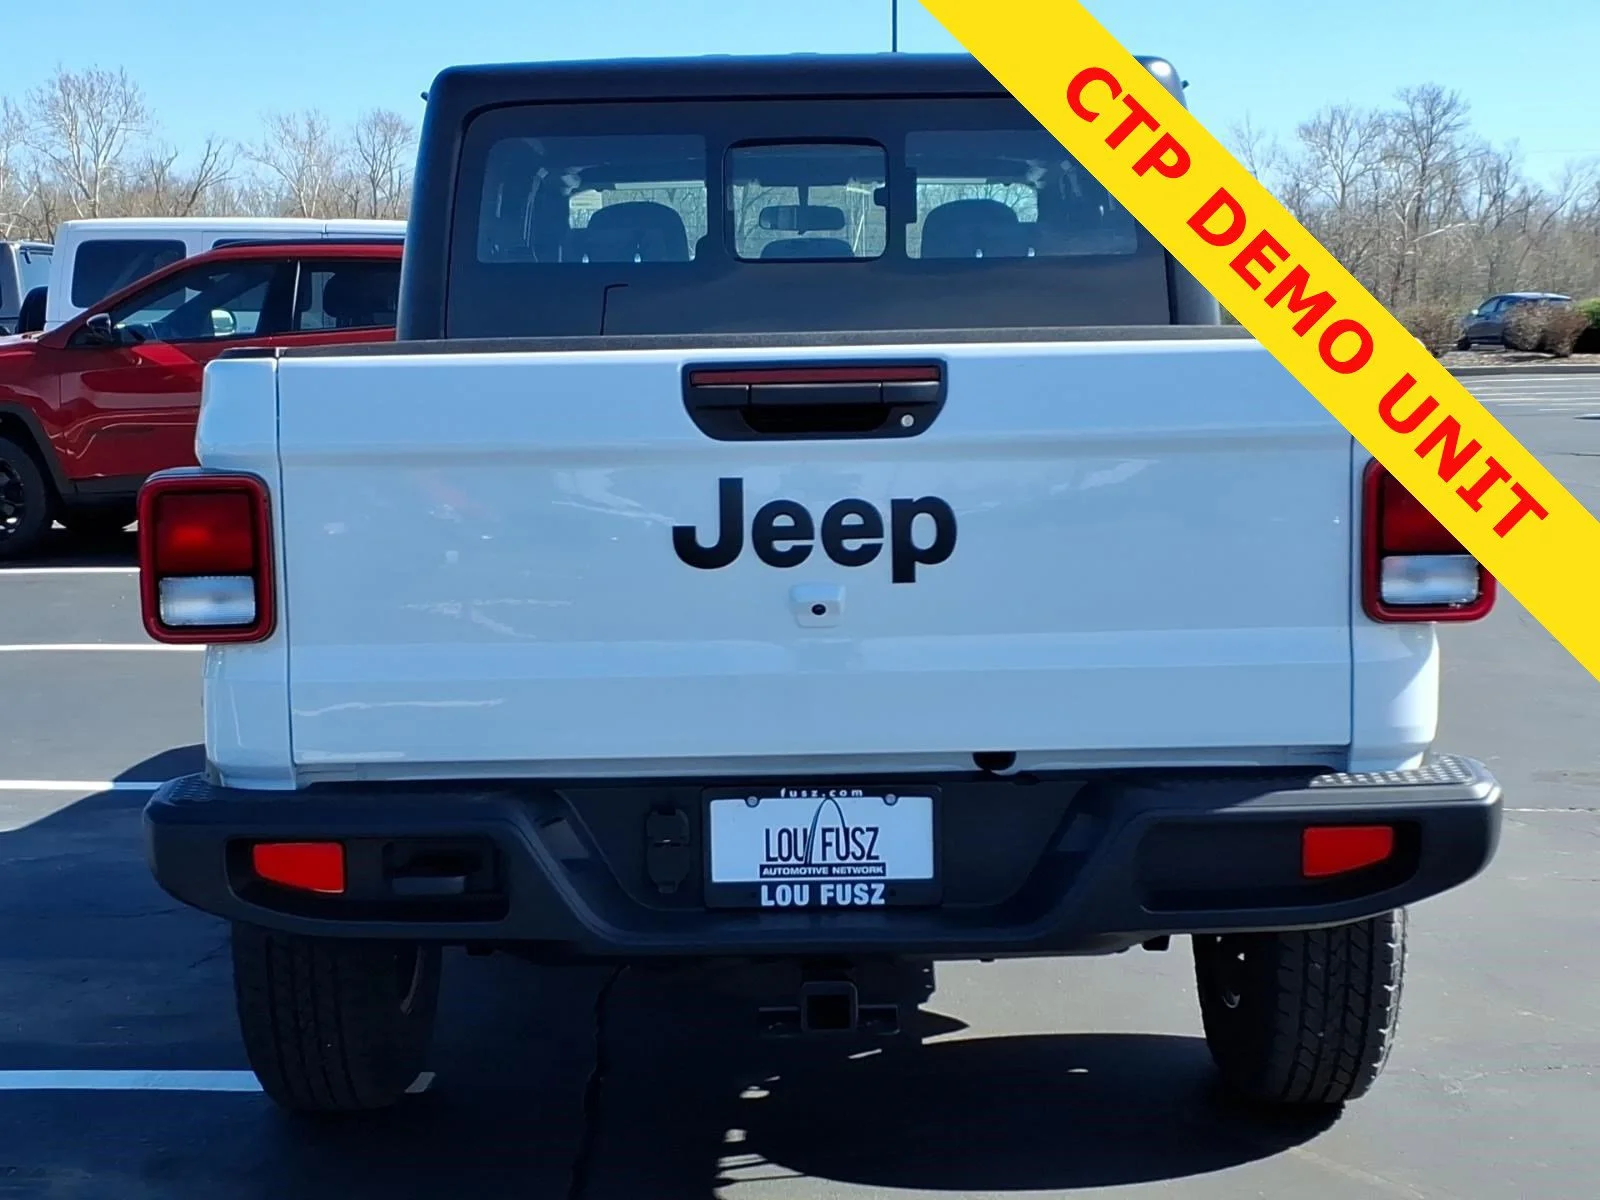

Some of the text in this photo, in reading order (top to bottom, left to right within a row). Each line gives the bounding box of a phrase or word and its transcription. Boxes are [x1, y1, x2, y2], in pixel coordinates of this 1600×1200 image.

[673, 477, 957, 583] Jeep
[780, 787, 863, 798] fusz.com
[765, 827, 880, 862] LOU FUSZ
[762, 865, 884, 876] AUTOMOTIVE NETWORK
[761, 883, 885, 906] LOU FUSZ
